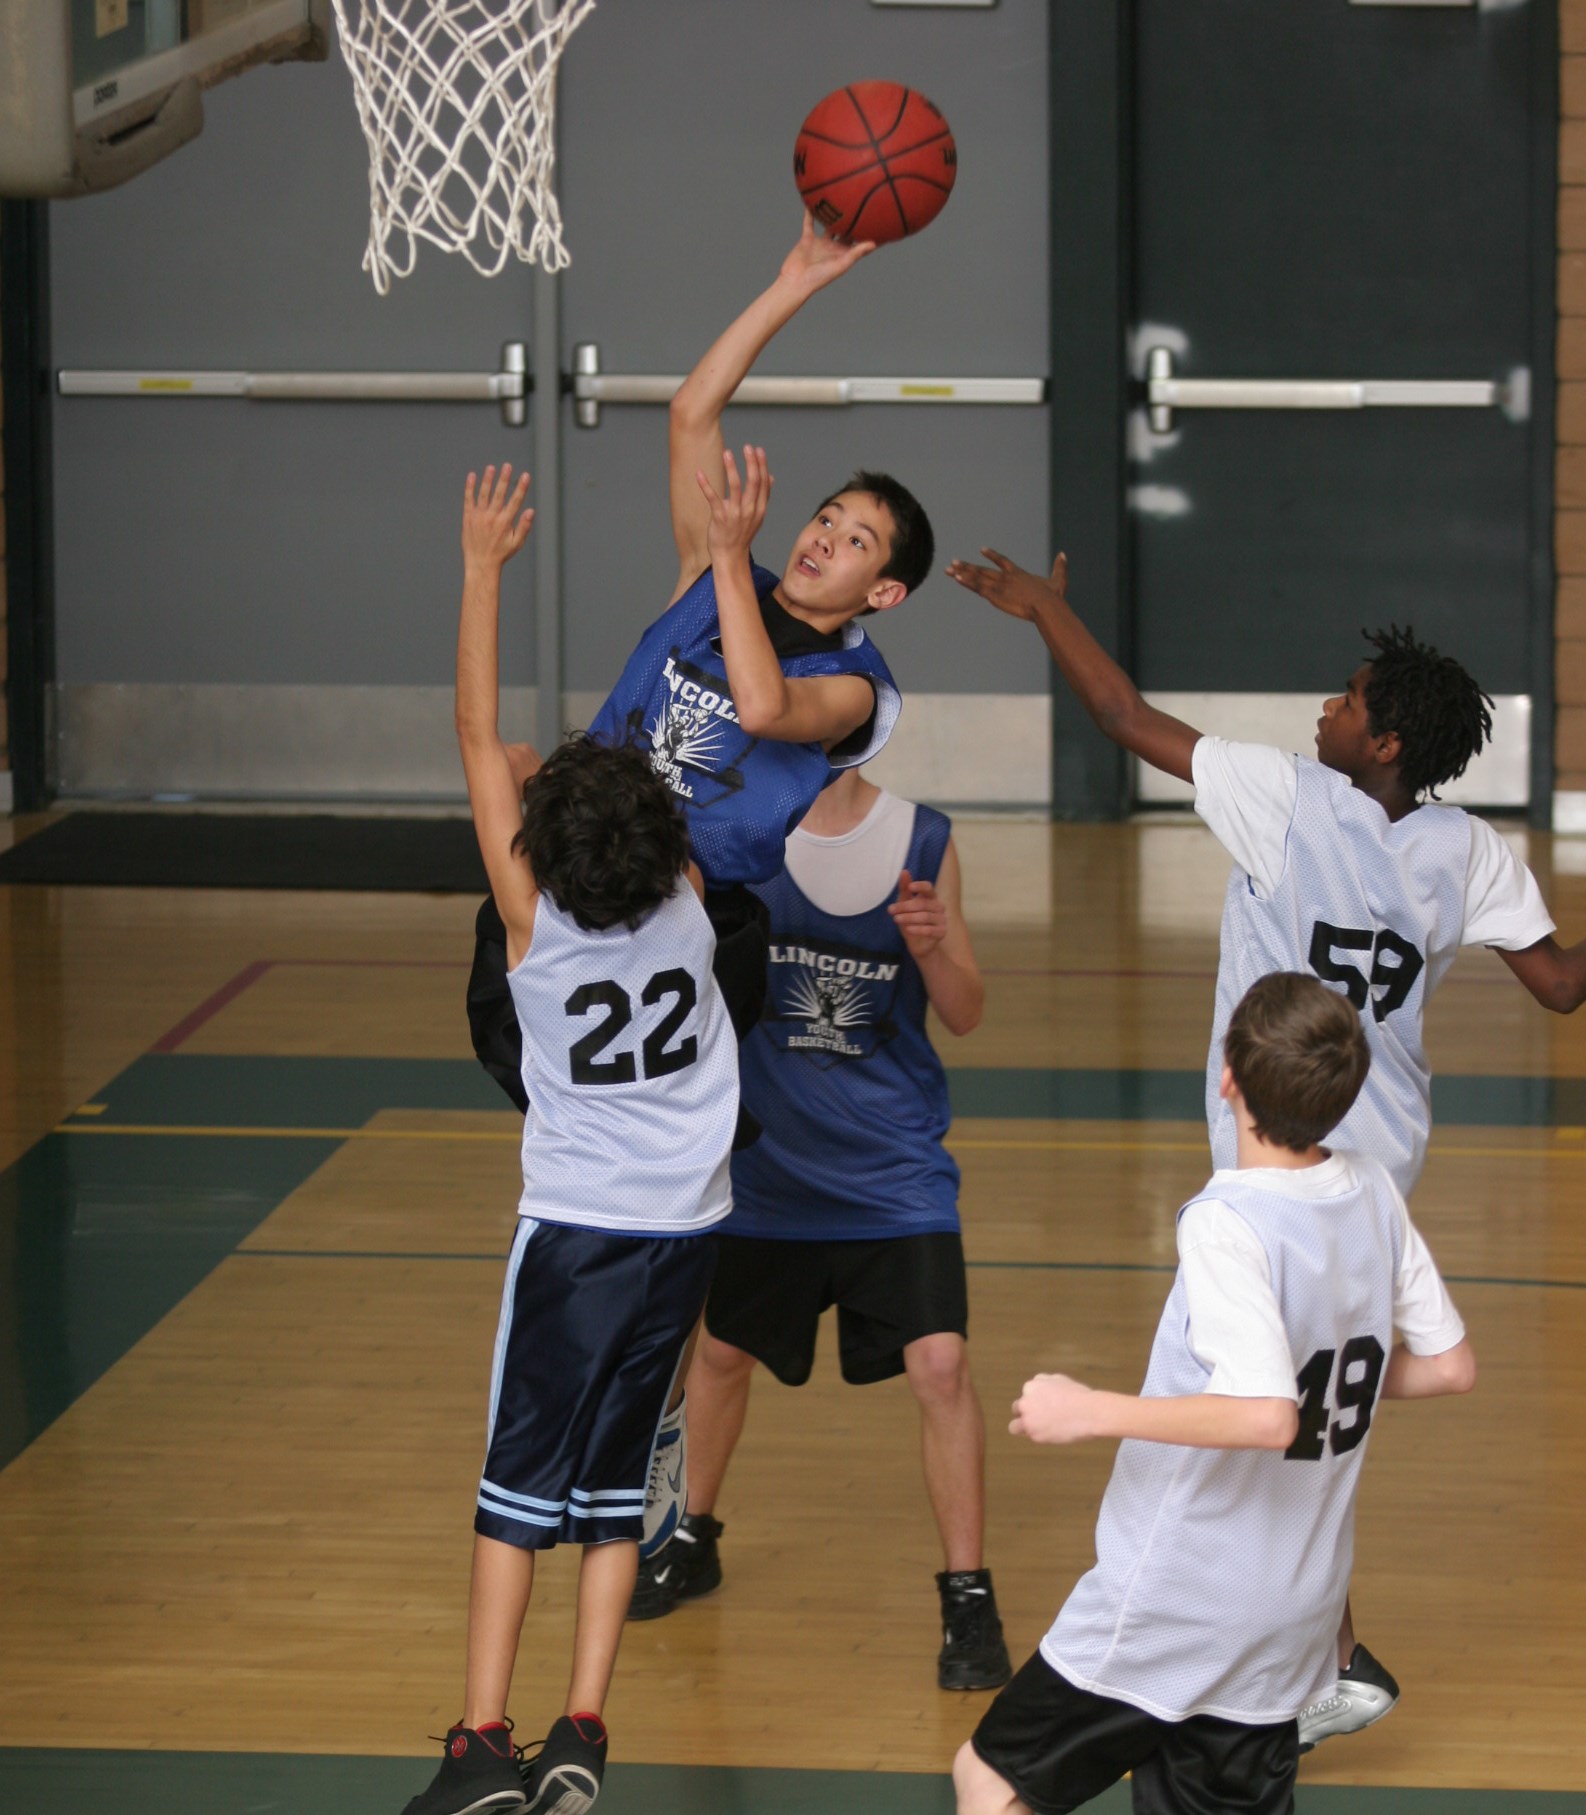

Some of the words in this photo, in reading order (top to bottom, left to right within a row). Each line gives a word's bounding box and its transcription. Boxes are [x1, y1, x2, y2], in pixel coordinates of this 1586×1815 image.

[768, 945, 900, 981] LINCOLN
[1308, 920, 1425, 1023] 59
[564, 967, 697, 1085] 22
[788, 1035, 864, 1055] BASKETBALL
[806, 1023, 846, 1042] YOUTH
[1283, 1334, 1385, 1461] 49
